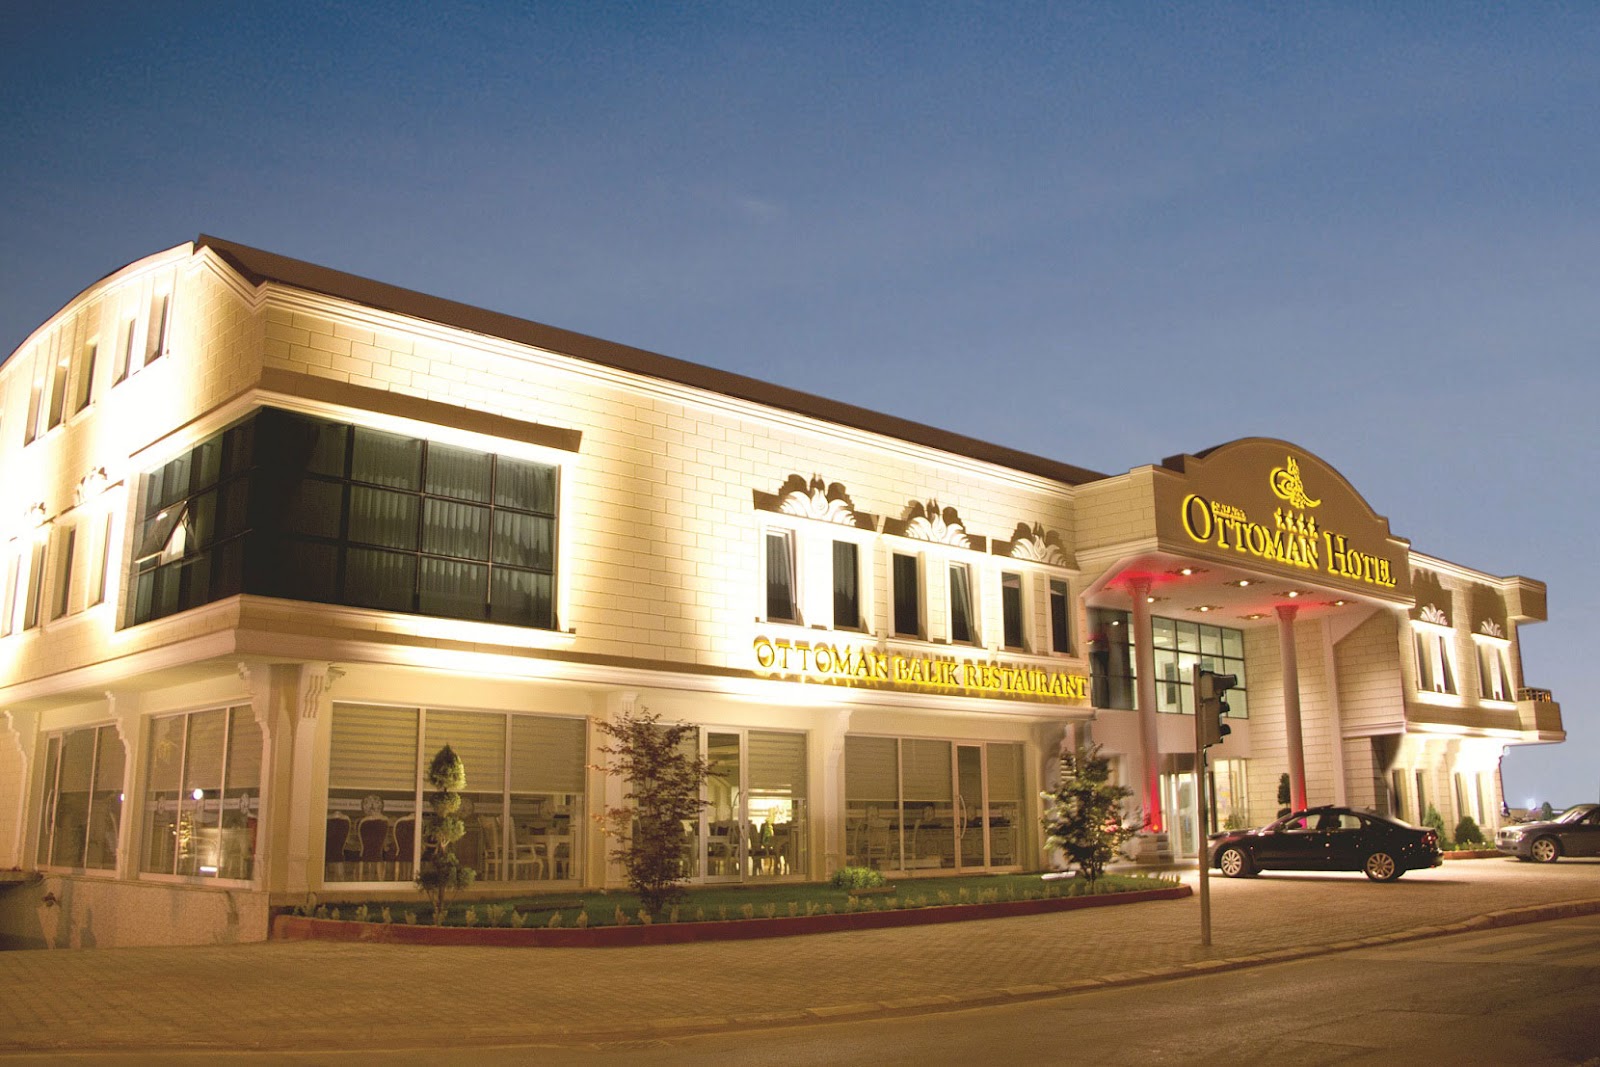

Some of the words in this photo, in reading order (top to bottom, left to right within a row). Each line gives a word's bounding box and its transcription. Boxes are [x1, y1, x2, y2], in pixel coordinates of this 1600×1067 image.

[1182, 494, 1319, 569] OTTOMAN
[1324, 531, 1397, 586] HOTEL
[754, 639, 889, 680] OTTOMAN
[892, 656, 960, 688] BALIK
[965, 664, 1089, 699] RESTAURANT
